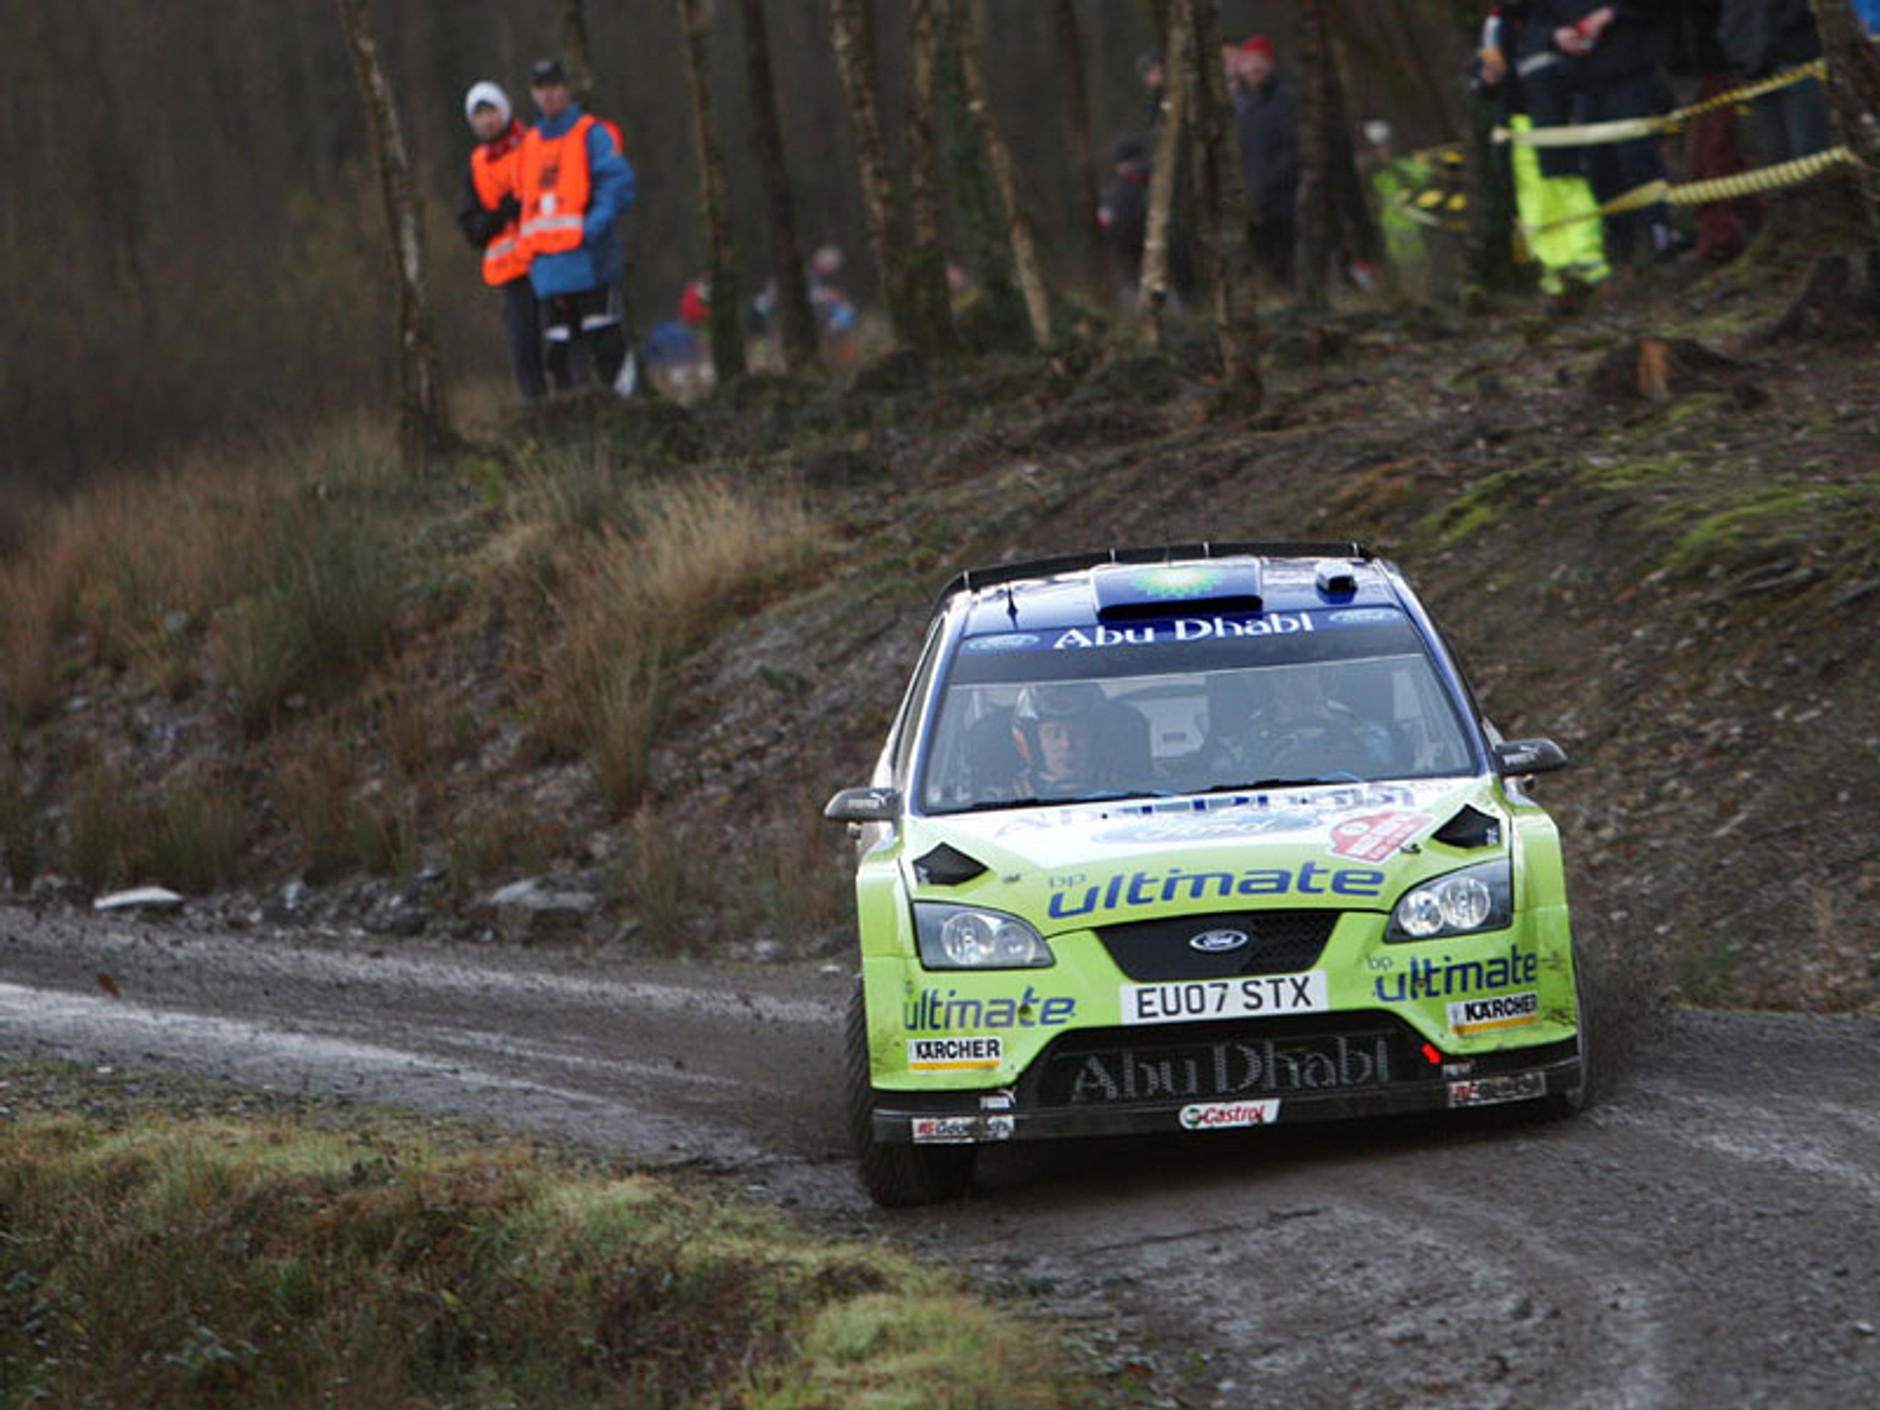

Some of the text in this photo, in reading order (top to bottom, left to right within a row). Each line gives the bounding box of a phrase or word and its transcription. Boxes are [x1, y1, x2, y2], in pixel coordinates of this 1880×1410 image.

[1053, 612, 1315, 650] Abu Dhabi
[1048, 861, 1386, 919] ultimate
[1049, 873, 1088, 889] bp
[1368, 955, 1393, 971] bp
[1376, 943, 1538, 1002] ultimate
[905, 985, 1076, 1031] ultimate
[1136, 976, 1313, 1019] EU07 STX
[1071, 1053, 1197, 1102] Abu
[1213, 1036, 1389, 1093] Dhabi
[1203, 1105, 1265, 1124] Castrol
